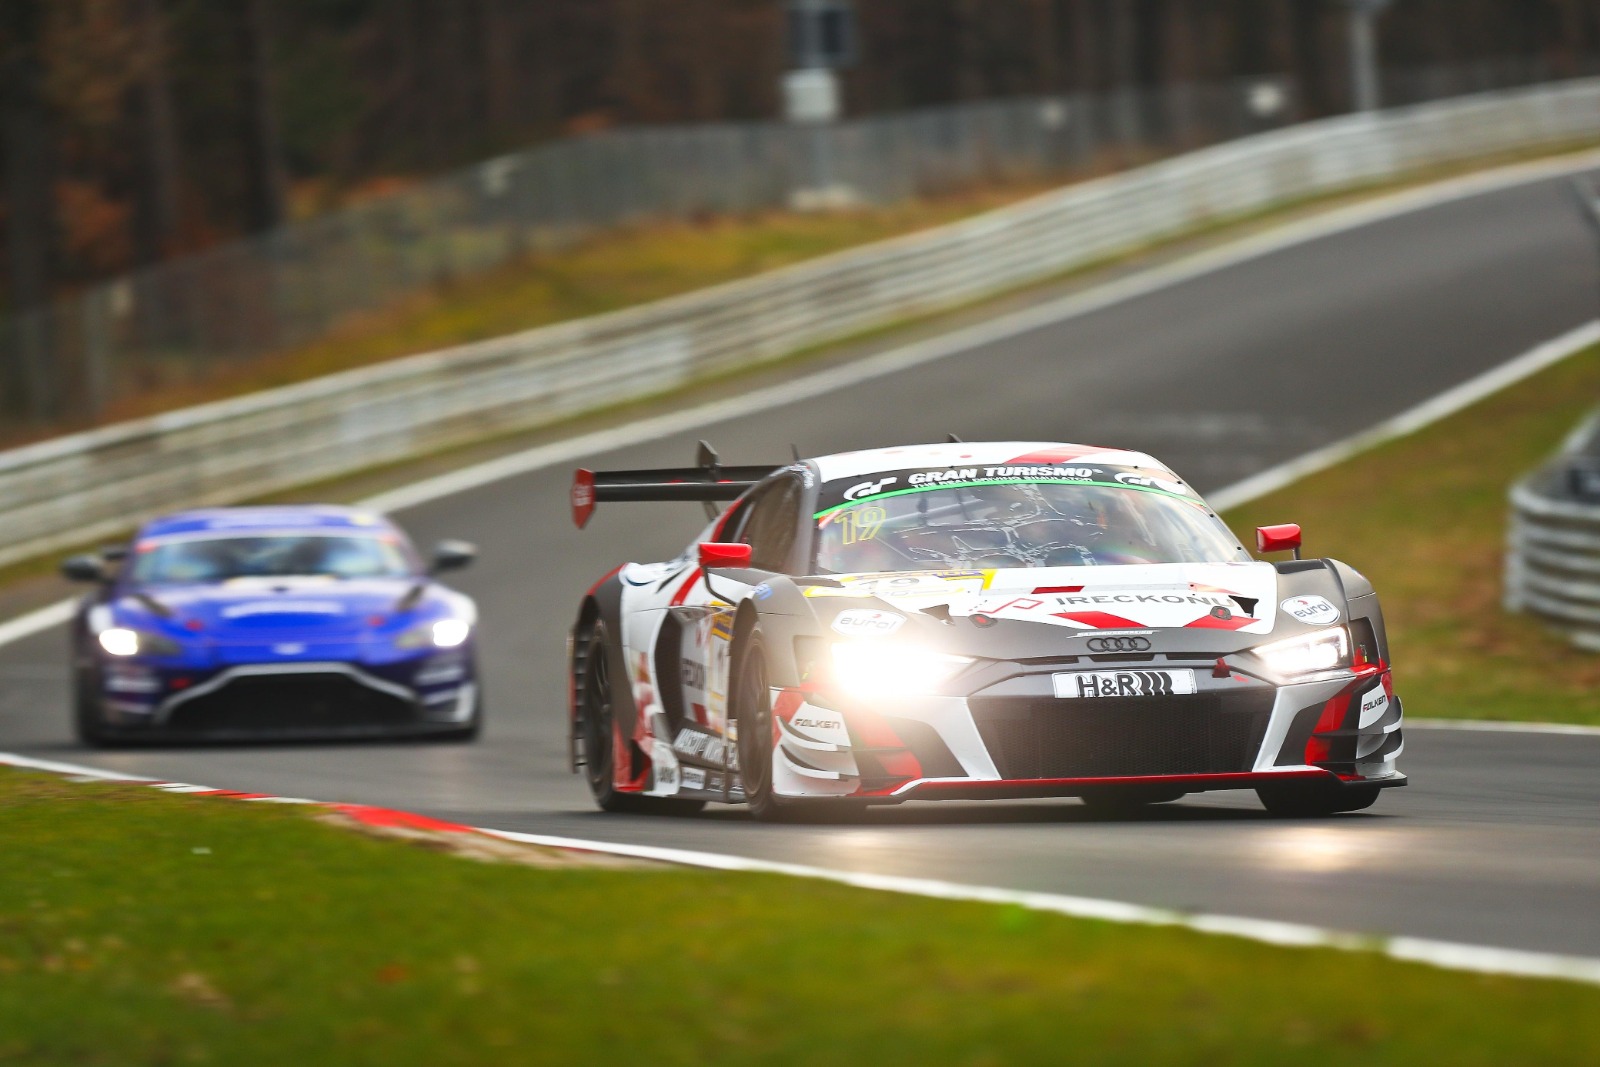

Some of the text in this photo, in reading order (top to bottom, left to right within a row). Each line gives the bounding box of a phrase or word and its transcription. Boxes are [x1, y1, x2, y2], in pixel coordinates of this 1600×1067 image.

[907, 466, 1093, 484] GRAN TURISMO
[833, 506, 887, 545] 19
[1293, 600, 1333, 618] eurol
[839, 616, 897, 630] eurol
[1076, 673, 1138, 698] H&R
[1363, 694, 1386, 713] FALKEN
[794, 718, 841, 730] FALKEN
